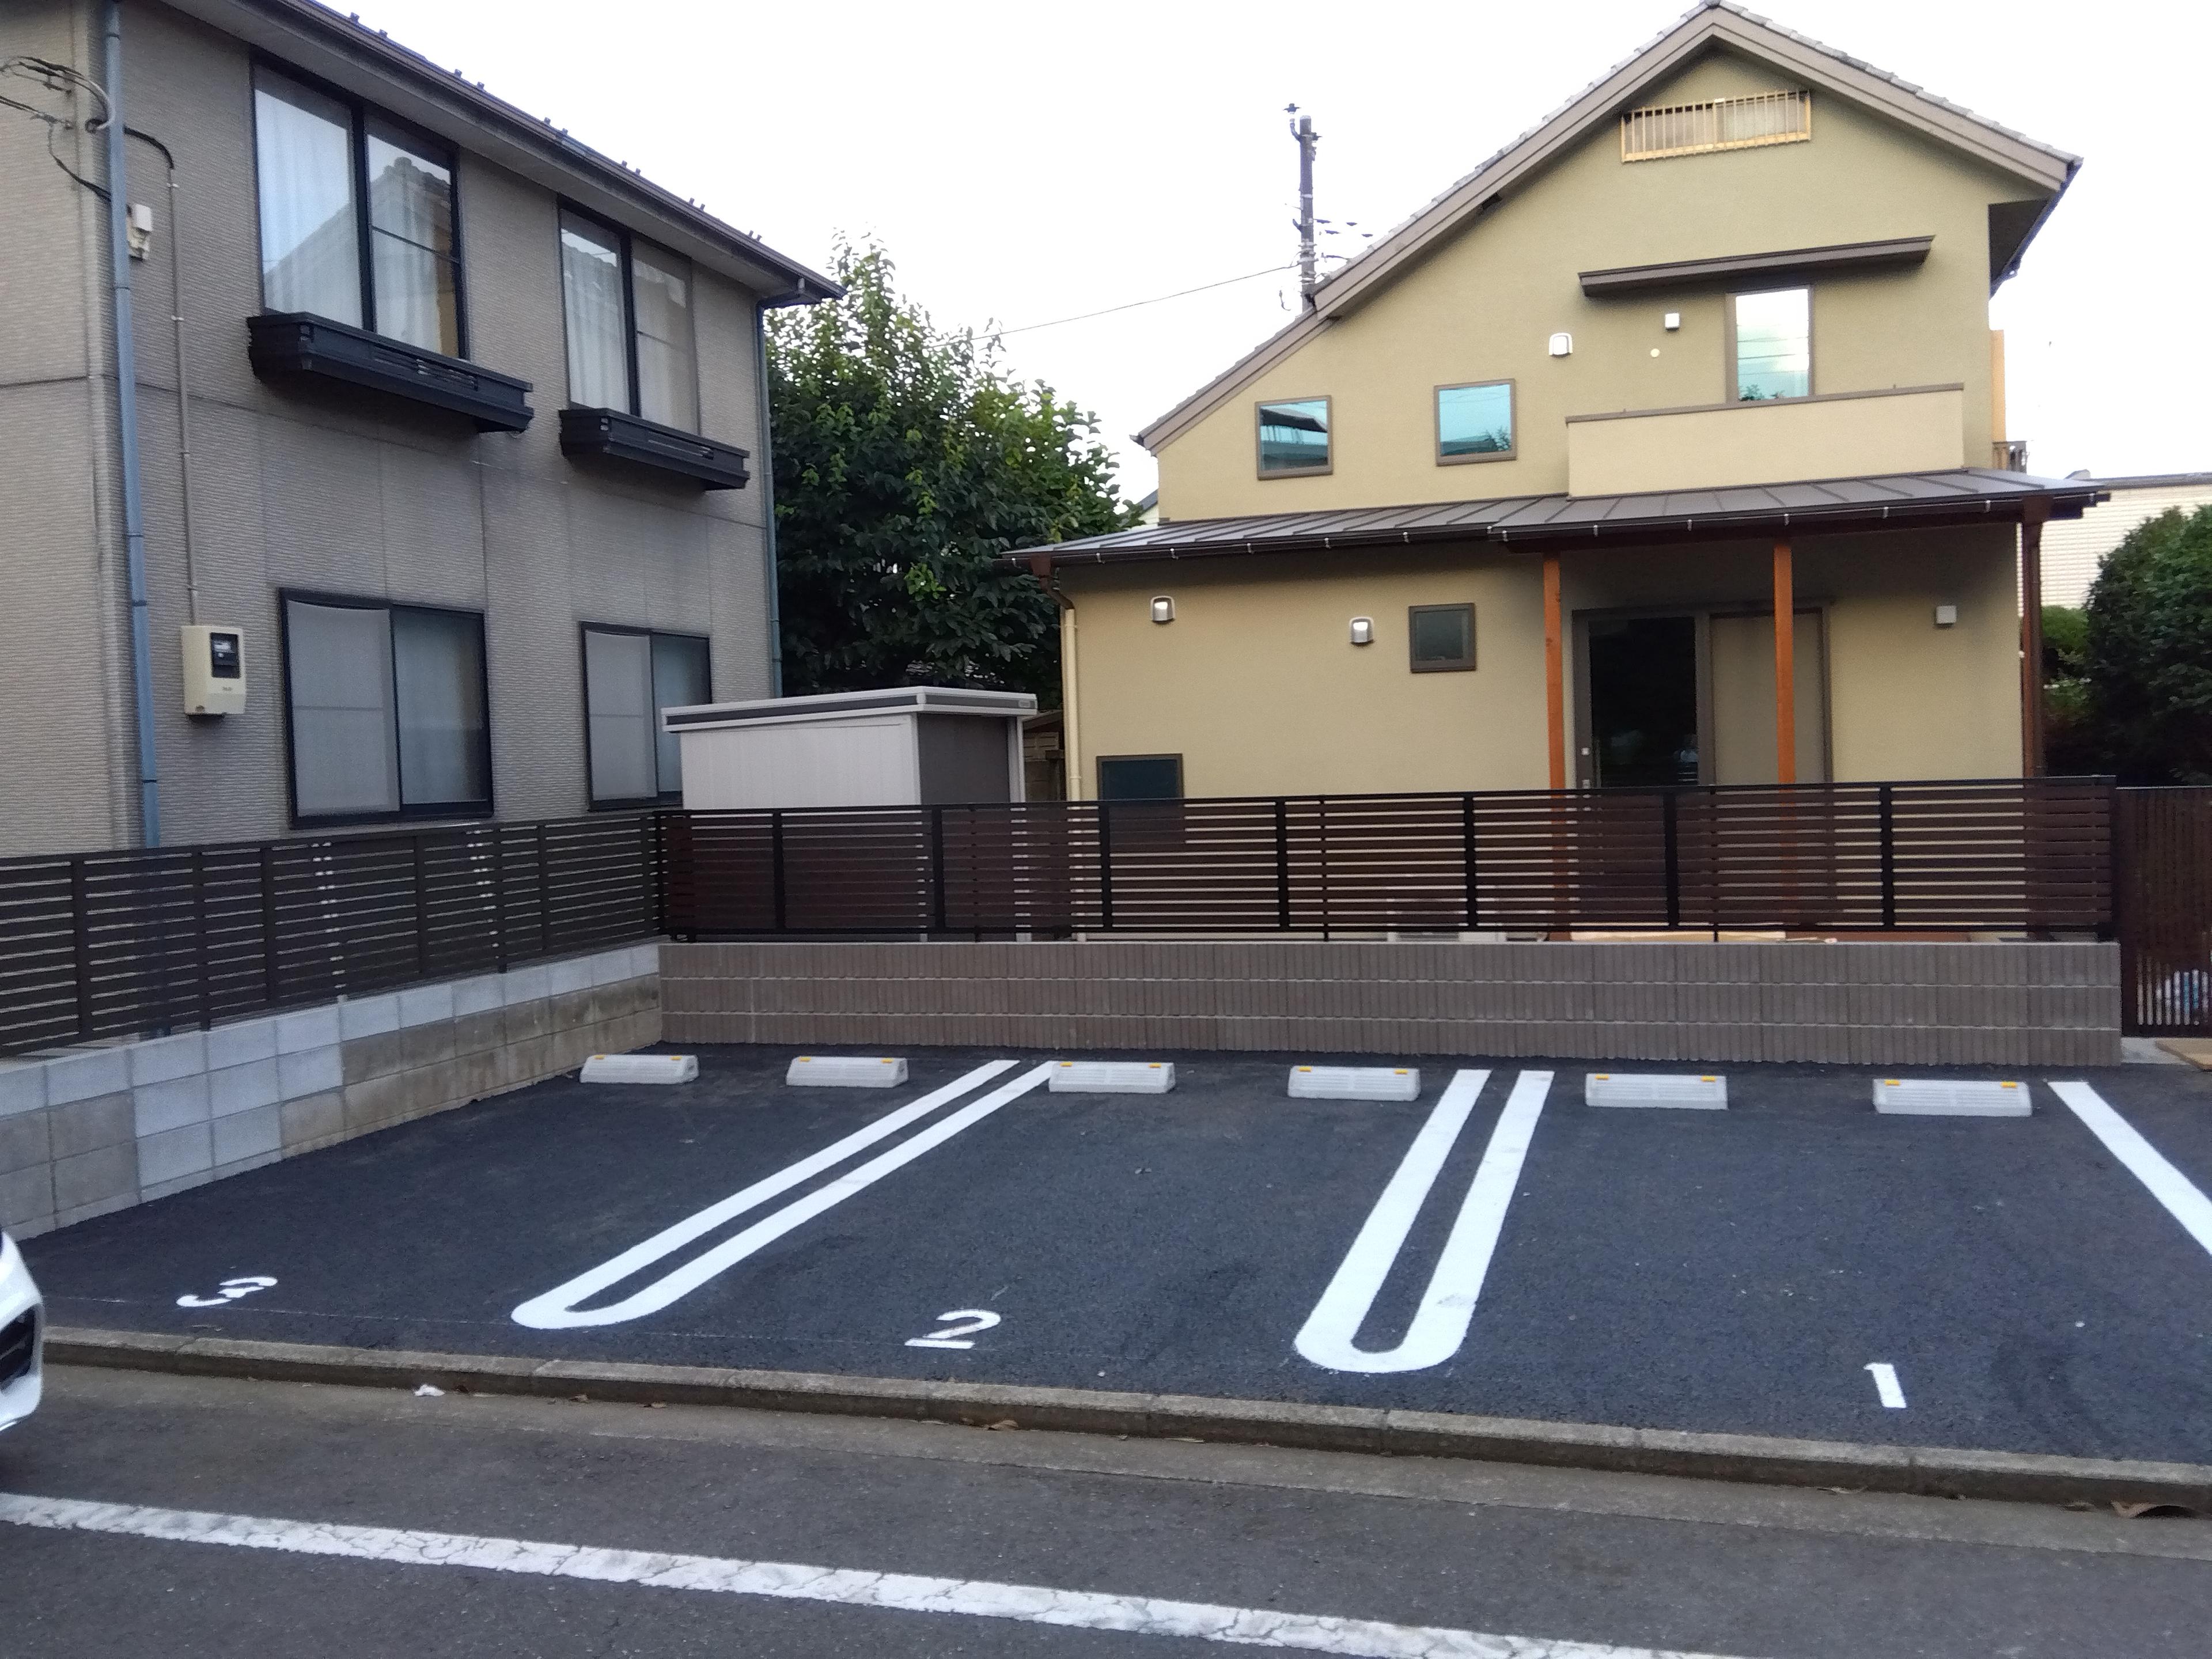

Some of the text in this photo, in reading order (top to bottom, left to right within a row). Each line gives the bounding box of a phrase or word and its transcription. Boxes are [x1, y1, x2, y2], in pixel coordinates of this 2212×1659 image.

[176, 1276, 278, 1307] 3
[904, 1309, 1001, 1349] 2
[1863, 1362, 1907, 1408] 1
